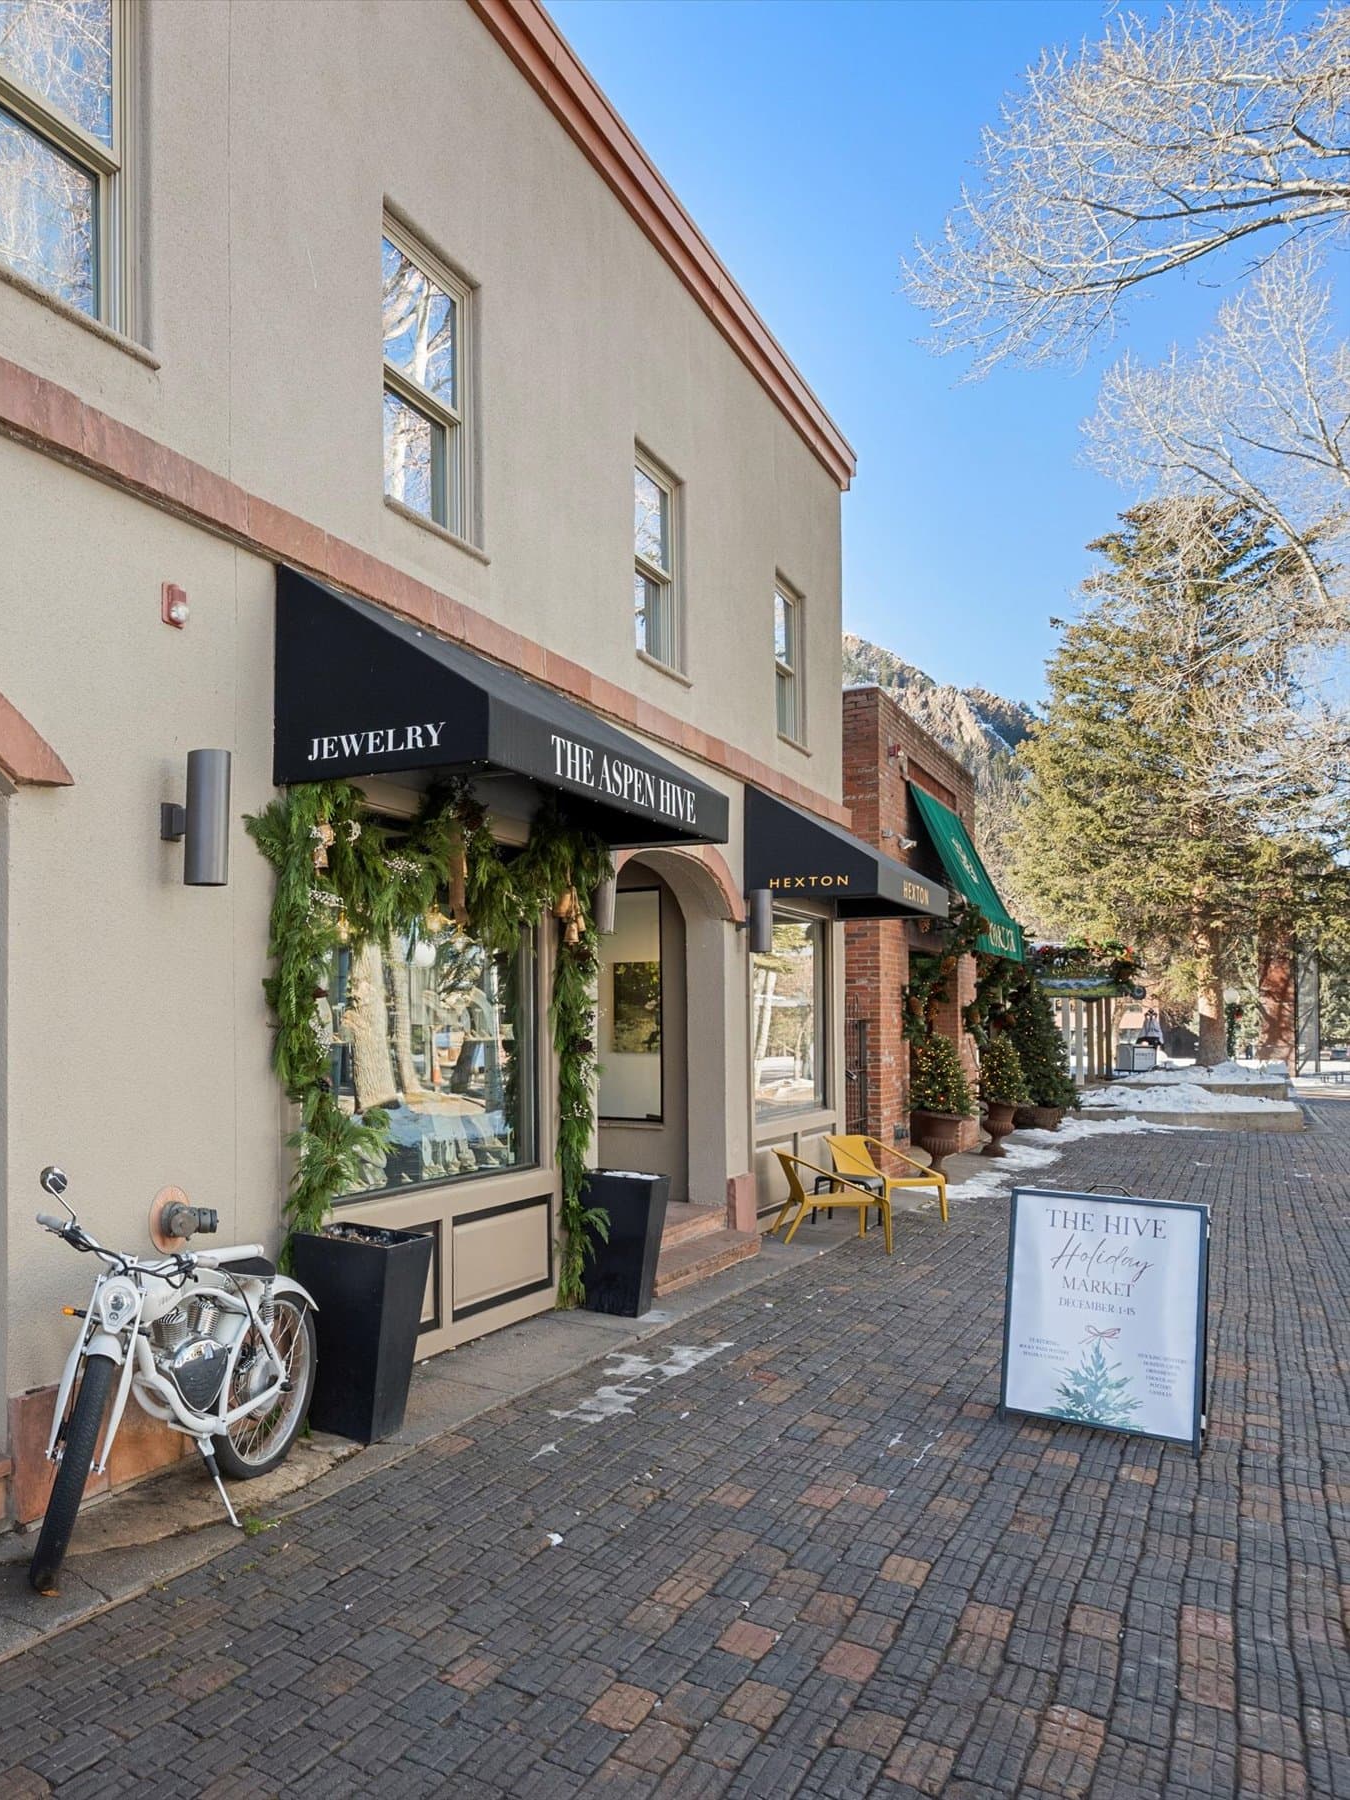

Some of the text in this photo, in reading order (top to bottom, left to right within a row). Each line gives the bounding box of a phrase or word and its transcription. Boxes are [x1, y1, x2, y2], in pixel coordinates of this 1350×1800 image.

[307, 721, 446, 762] JEWELRY
[551, 734, 697, 825] THE ASPEN HIVE
[769, 875, 850, 889] HEXTON
[903, 880, 930, 906] HEXTON
[1045, 1208, 1167, 1239] THE HIVE
[1050, 1232, 1154, 1283] Holiday
[1062, 1275, 1135, 1297] MARKET
[1058, 1297, 1115, 1313] DECEMBER
